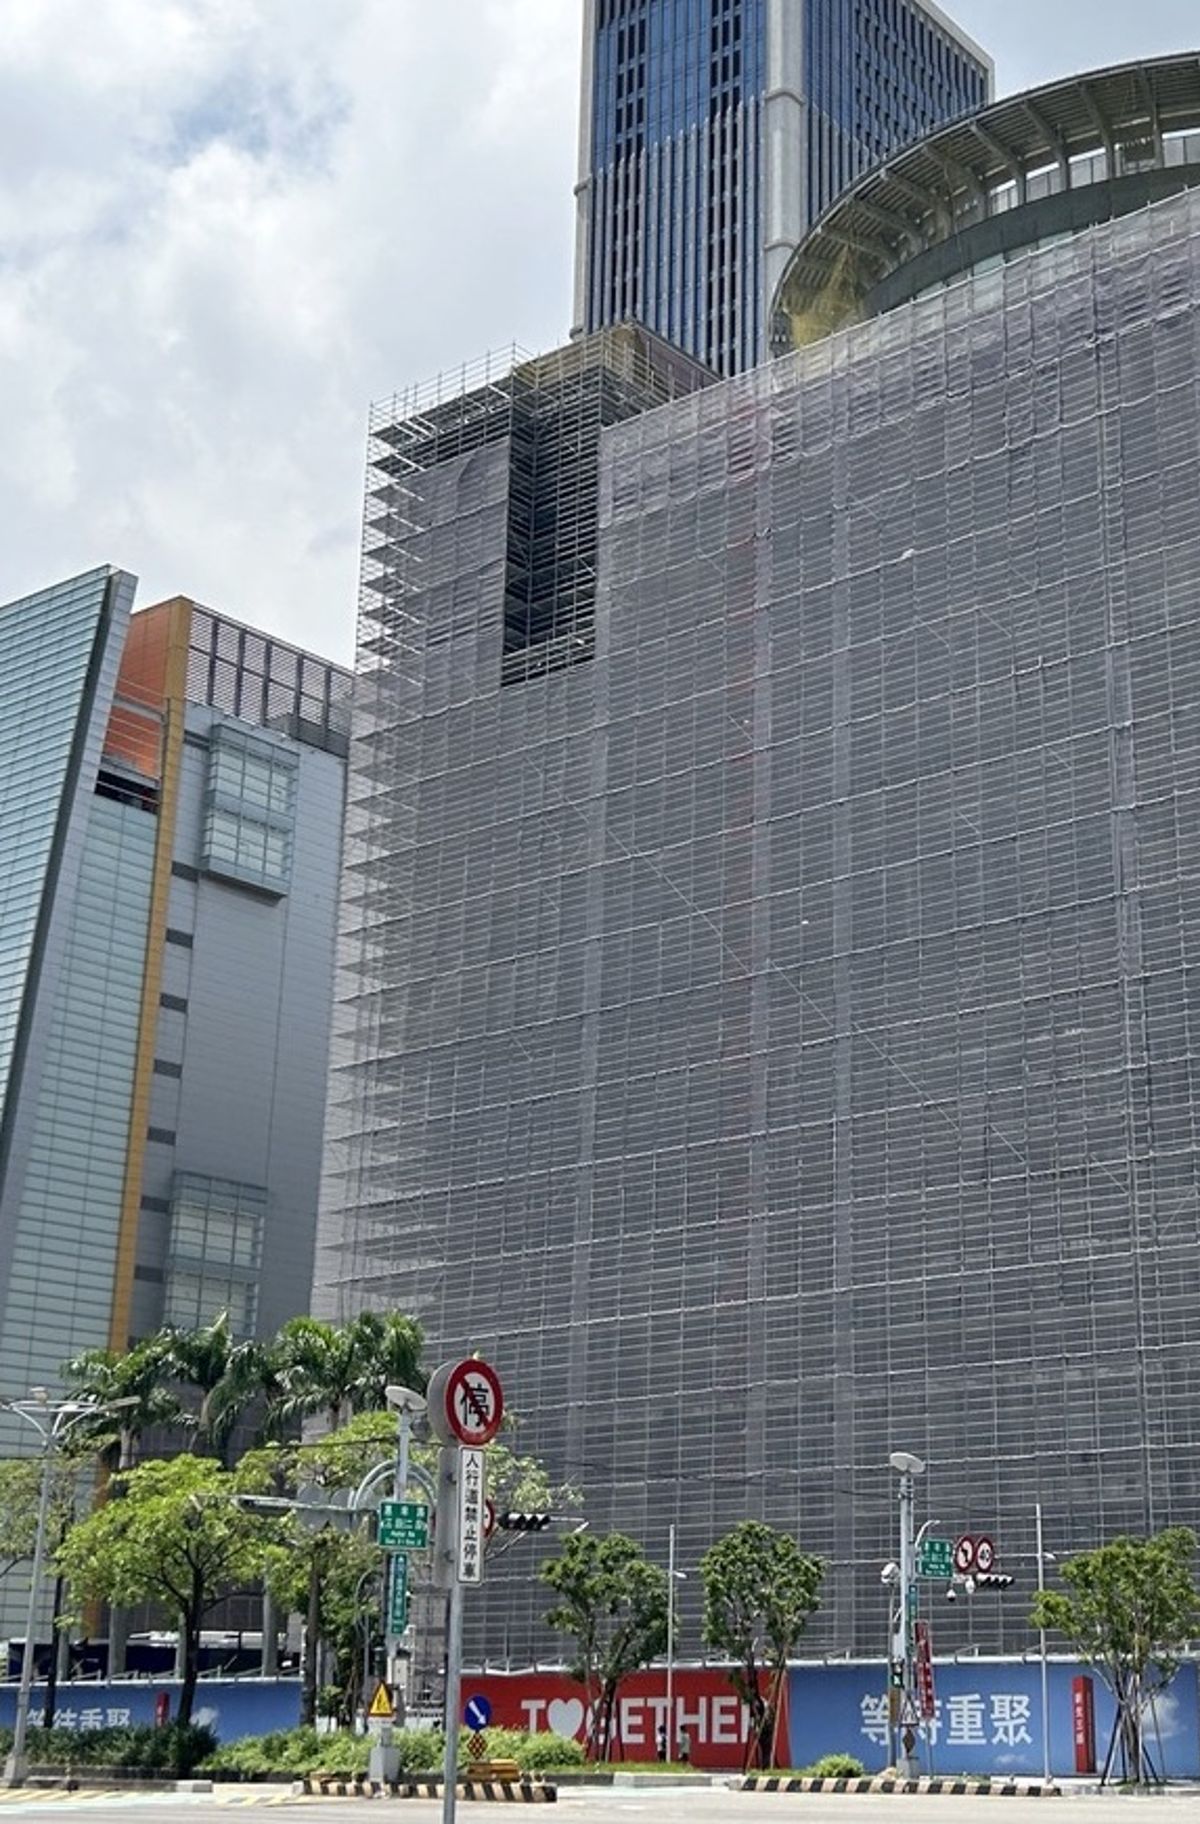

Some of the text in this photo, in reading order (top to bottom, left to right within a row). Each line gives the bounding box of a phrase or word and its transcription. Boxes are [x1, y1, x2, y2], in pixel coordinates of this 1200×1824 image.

[460, 1383, 489, 1427] 停
[463, 1453, 480, 1578] 人行道禁止停車
